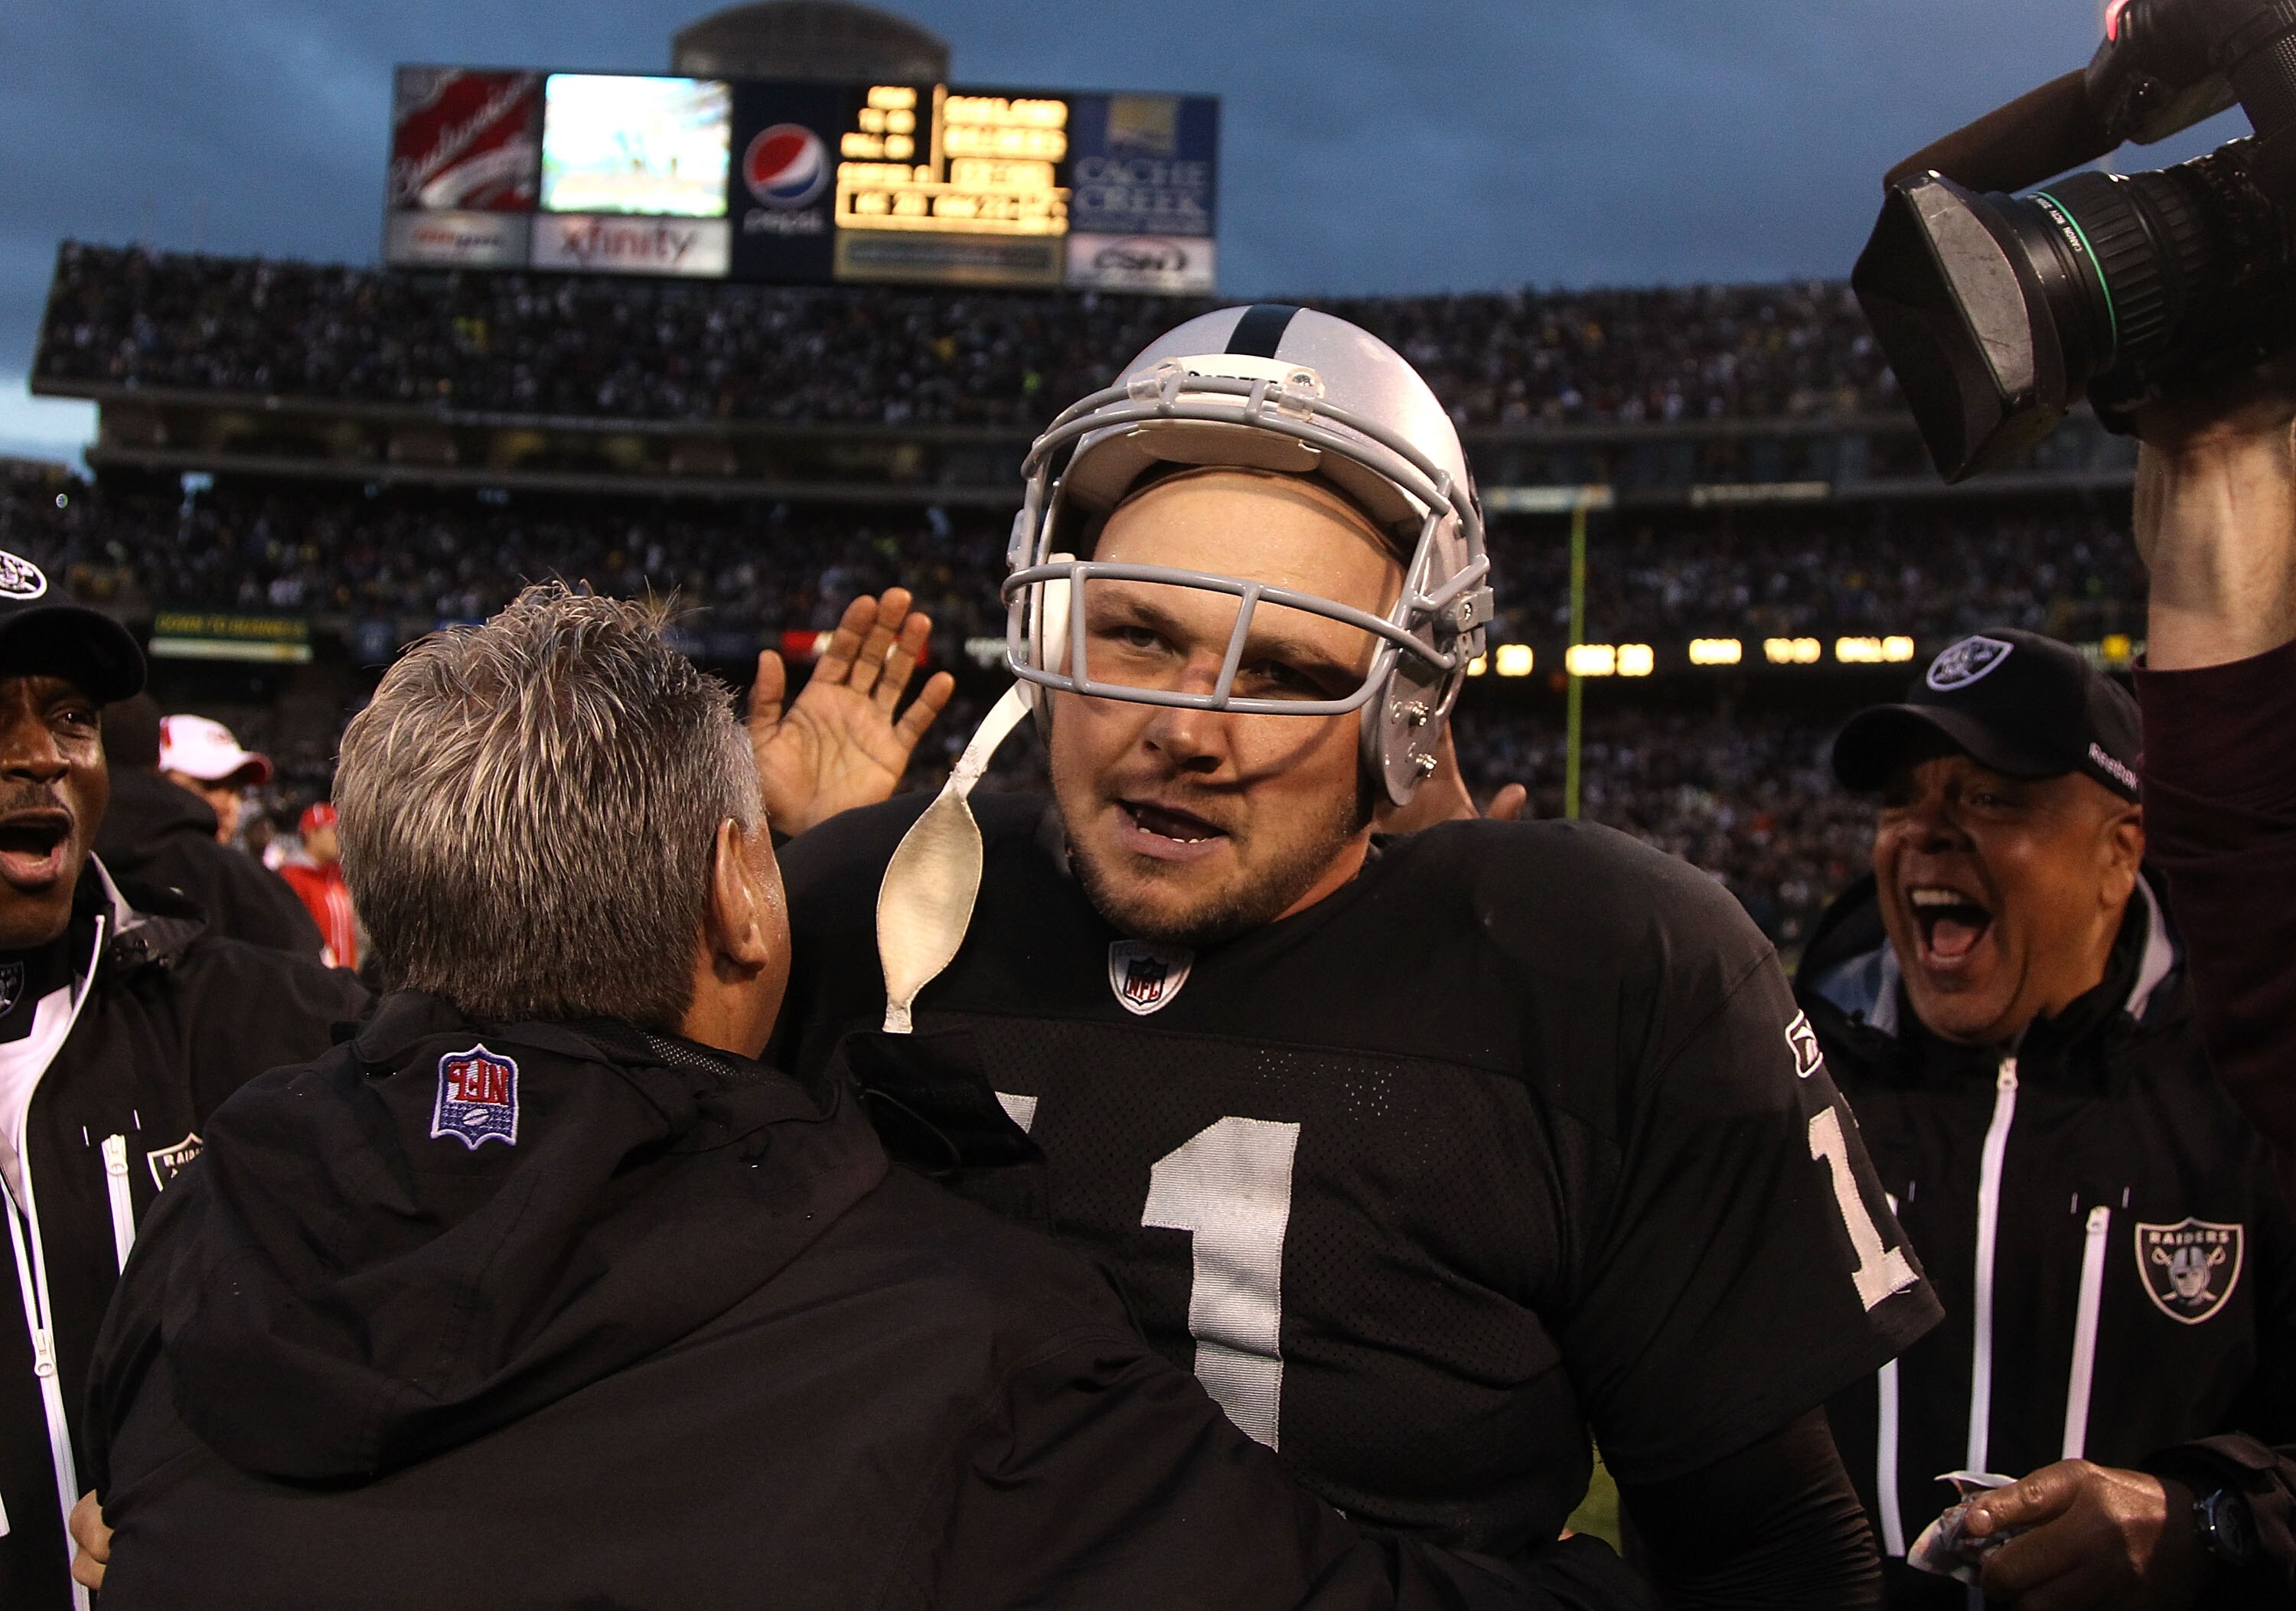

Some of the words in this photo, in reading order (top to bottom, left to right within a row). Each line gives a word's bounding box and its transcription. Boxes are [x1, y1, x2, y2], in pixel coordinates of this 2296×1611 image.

[447, 1058, 511, 1105] NFL
[1809, 1106, 1919, 1313] 1
[2148, 1231, 2230, 1245] RAIDERS
